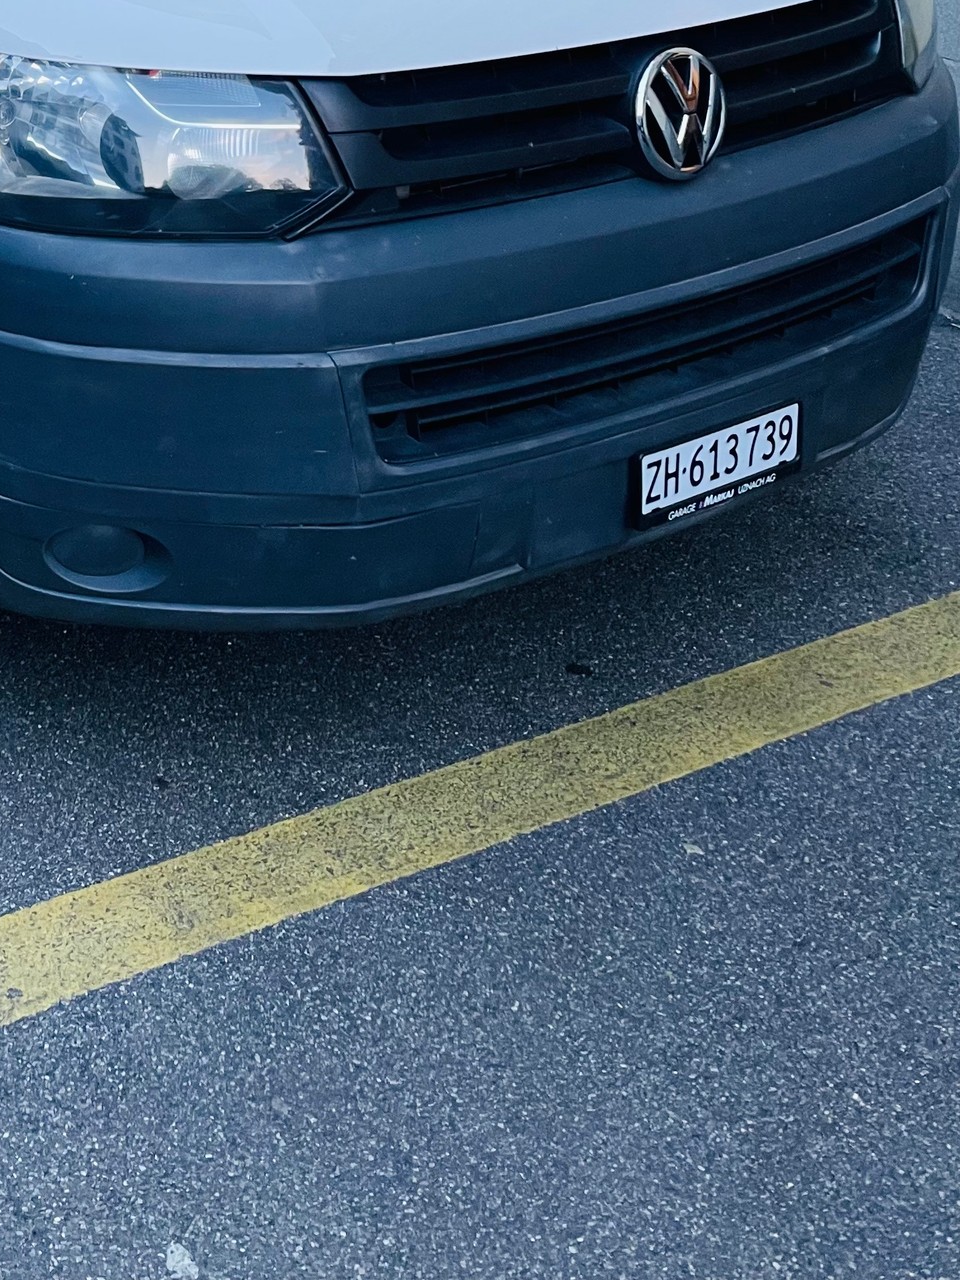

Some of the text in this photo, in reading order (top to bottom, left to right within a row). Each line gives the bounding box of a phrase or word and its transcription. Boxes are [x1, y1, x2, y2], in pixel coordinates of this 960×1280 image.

[640, 52, 720, 174] VW
[668, 502, 697, 520] GARAGE
[765, 473, 776, 484] AG
